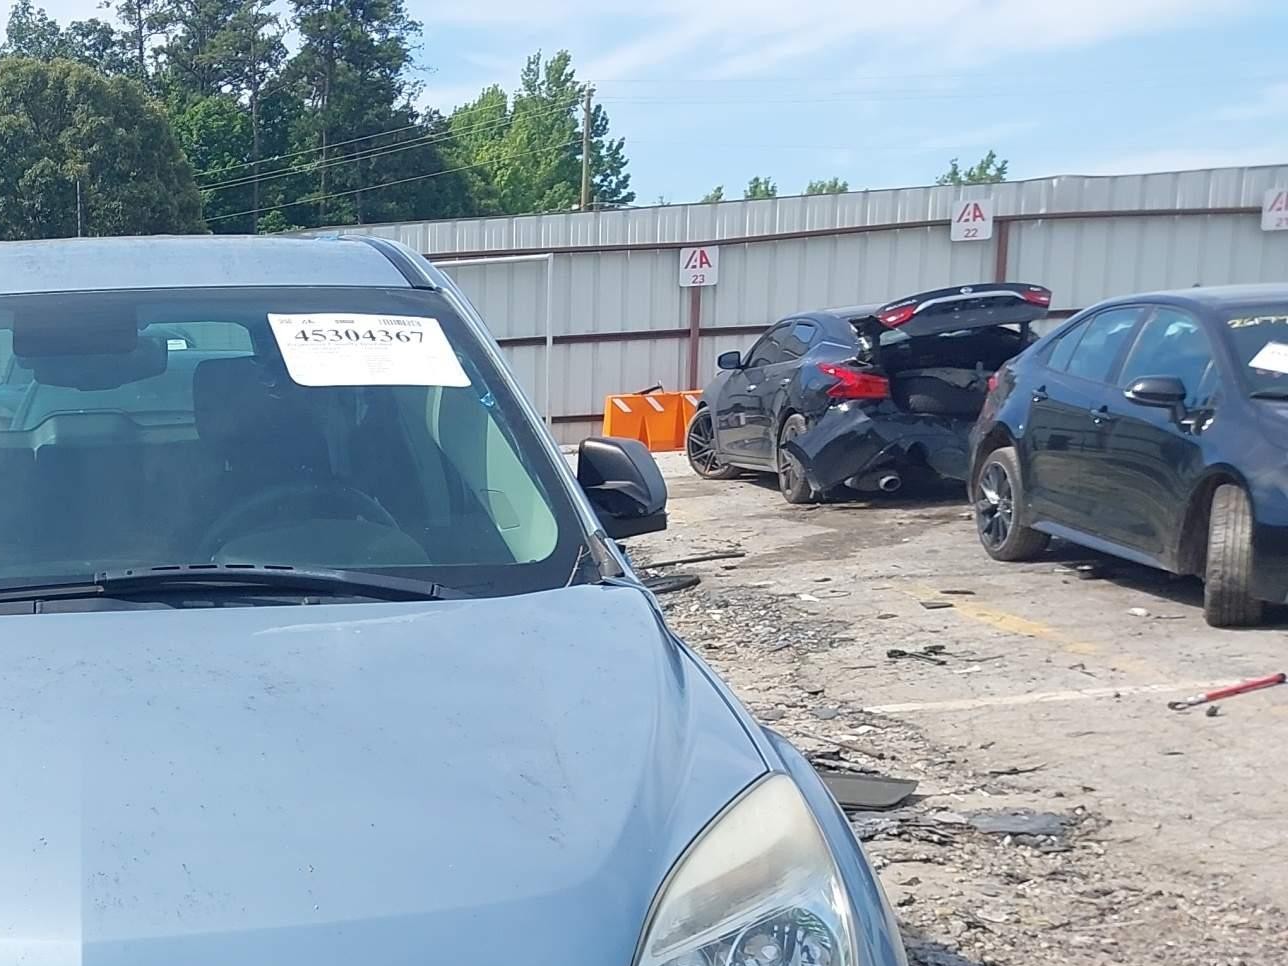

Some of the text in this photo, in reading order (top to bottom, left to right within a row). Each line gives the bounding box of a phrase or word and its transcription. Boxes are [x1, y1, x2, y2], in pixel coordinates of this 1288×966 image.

[964, 228, 978, 238] 22
[692, 274, 705, 284] 23
[294, 329, 423, 344] 45304367
